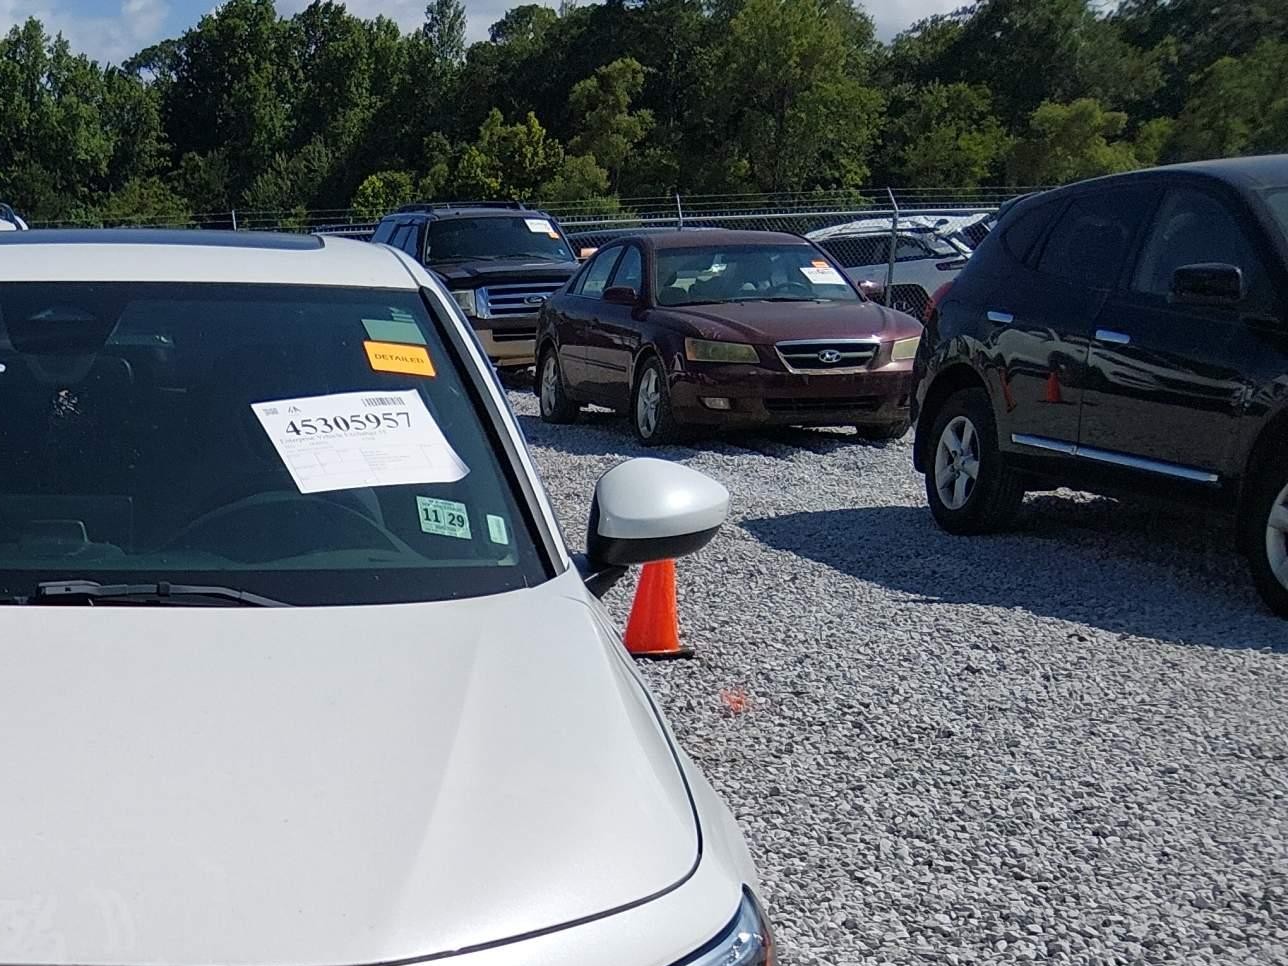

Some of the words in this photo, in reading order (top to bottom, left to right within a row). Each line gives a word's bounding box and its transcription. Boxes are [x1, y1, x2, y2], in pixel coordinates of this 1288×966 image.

[374, 353, 425, 364] DETAILED
[286, 412, 412, 436] 45305957
[422, 508, 441, 523] 11
[448, 513, 465, 528] 29
